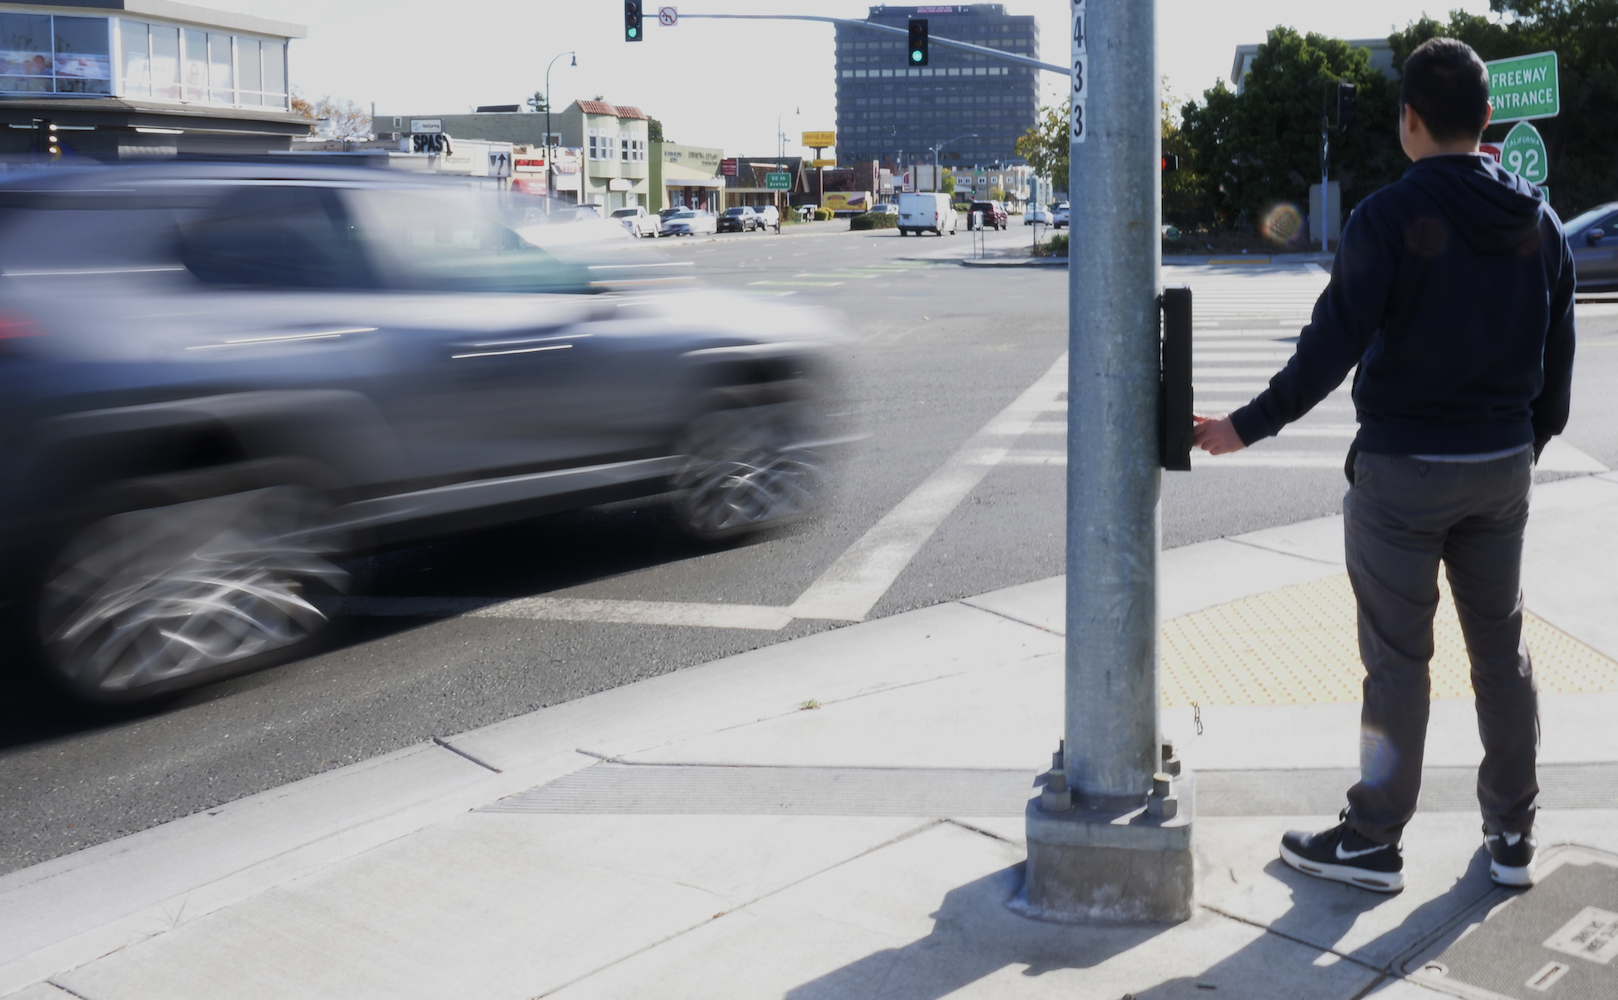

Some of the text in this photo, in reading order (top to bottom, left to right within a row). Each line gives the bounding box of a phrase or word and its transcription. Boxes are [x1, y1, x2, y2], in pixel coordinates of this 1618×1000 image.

[1491, 65, 1547, 89] FREEWAY
[1488, 87, 1553, 111] ENTRANCE
[413, 134, 443, 152] SPAS
[1506, 136, 1540, 149] CALIFORNIA
[1508, 148, 1540, 177] 92
